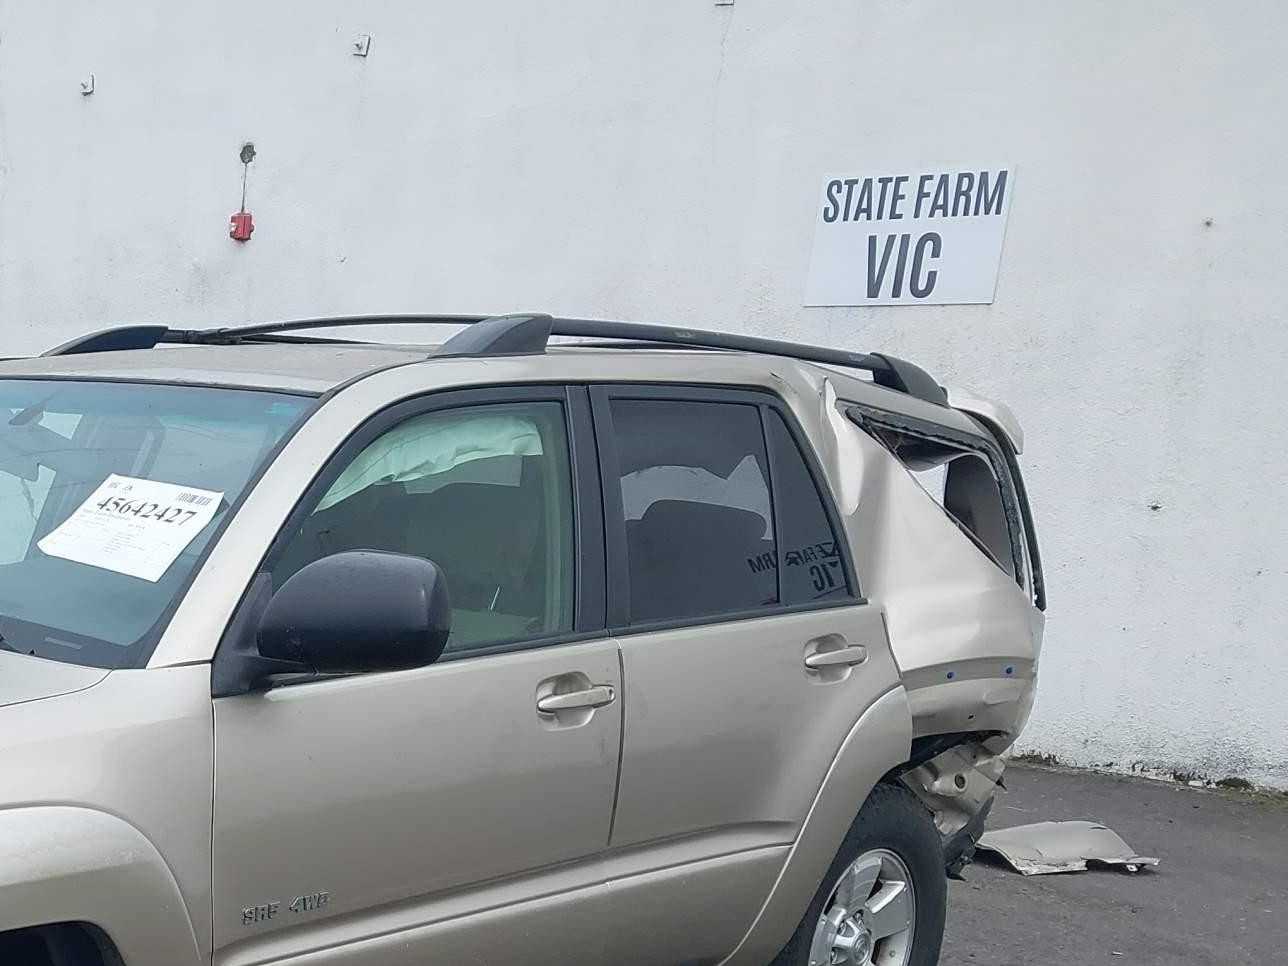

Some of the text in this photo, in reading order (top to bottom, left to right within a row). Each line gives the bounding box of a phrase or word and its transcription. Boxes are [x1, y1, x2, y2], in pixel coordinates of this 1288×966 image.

[822, 169, 1009, 223] STATE FARM
[866, 231, 943, 299] VIC
[96, 495, 198, 527] 45642427
